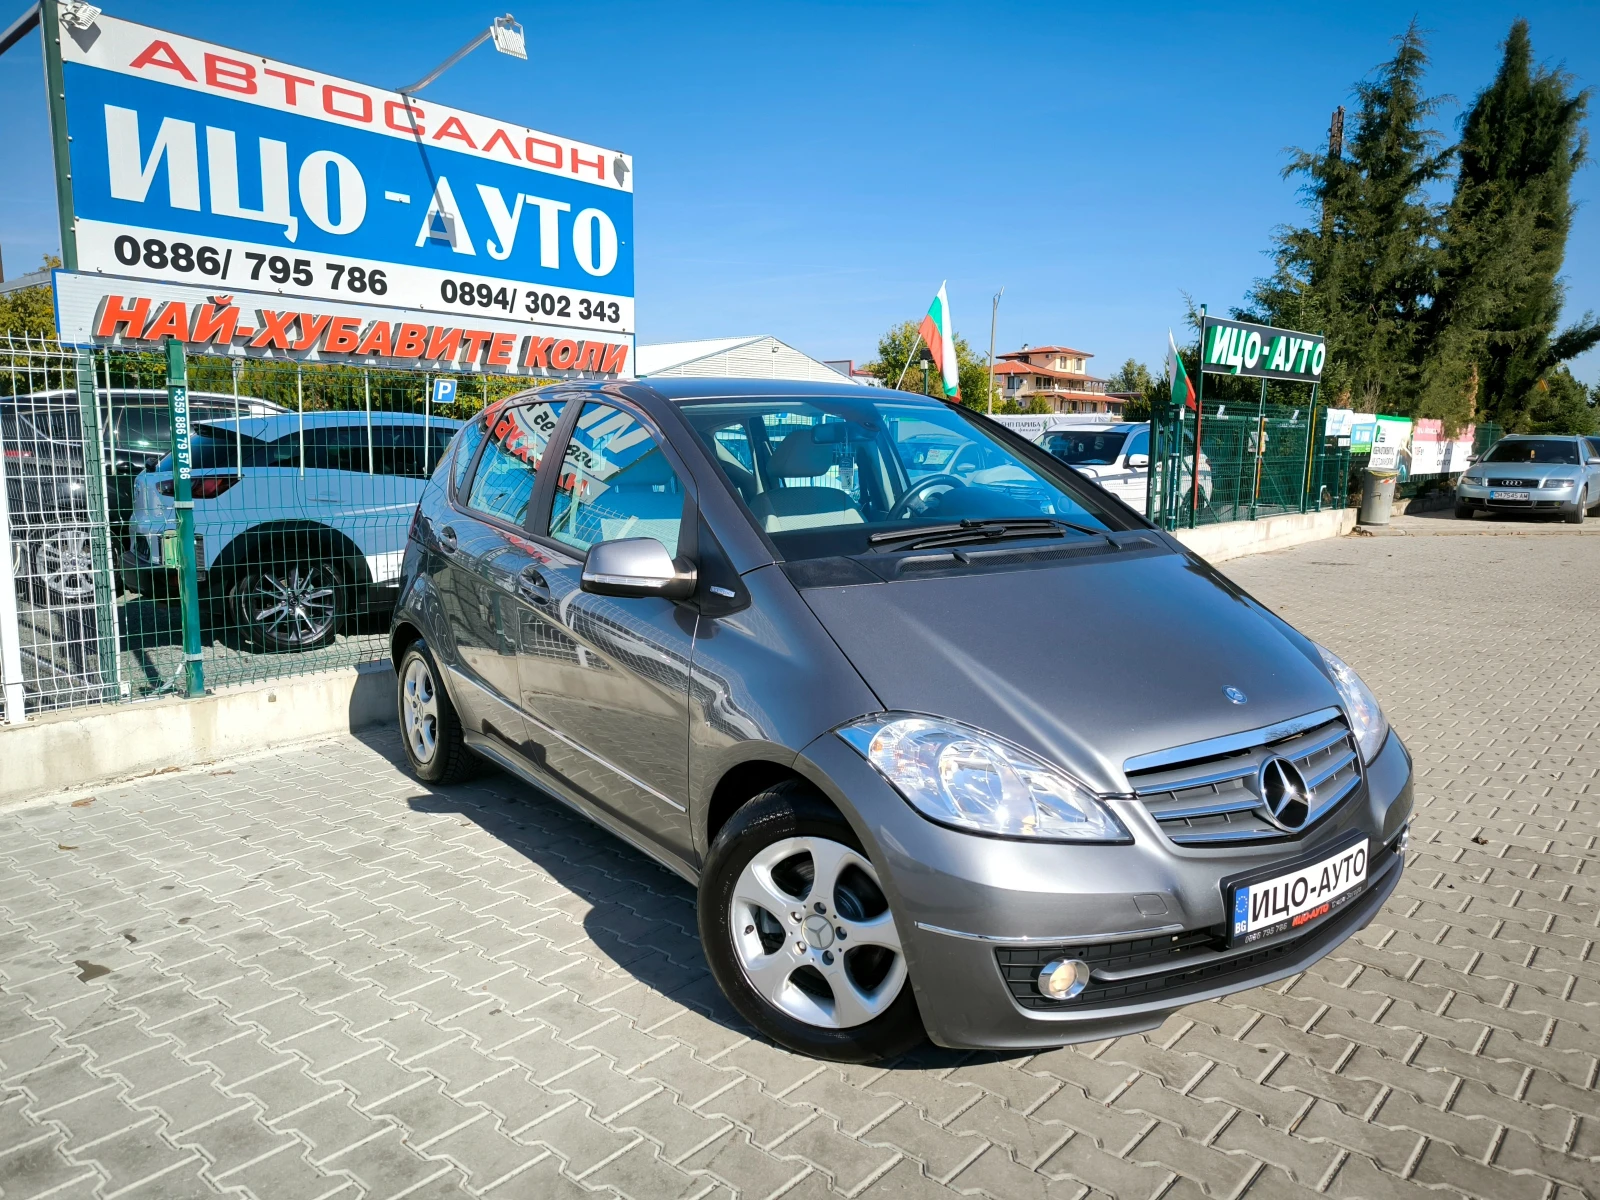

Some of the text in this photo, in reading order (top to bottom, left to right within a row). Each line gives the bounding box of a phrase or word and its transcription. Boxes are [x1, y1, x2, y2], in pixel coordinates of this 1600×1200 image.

[128, 39, 605, 180] АВТОСАЛОН
[244, 251, 314, 287] 795
[325, 263, 388, 296] 786
[95, 294, 629, 373] НАЙ-ХУБАВИТЕ КОЛИ
[525, 290, 571, 318] 302
[578, 298, 621, 324] 343
[1209, 325, 1326, 376] ИЦО-АУТО
[173, 388, 191, 480] +359 886 79 57 86
[1251, 848, 1366, 923] ИЦО-АУТО
[1235, 920, 1247, 934] BG
